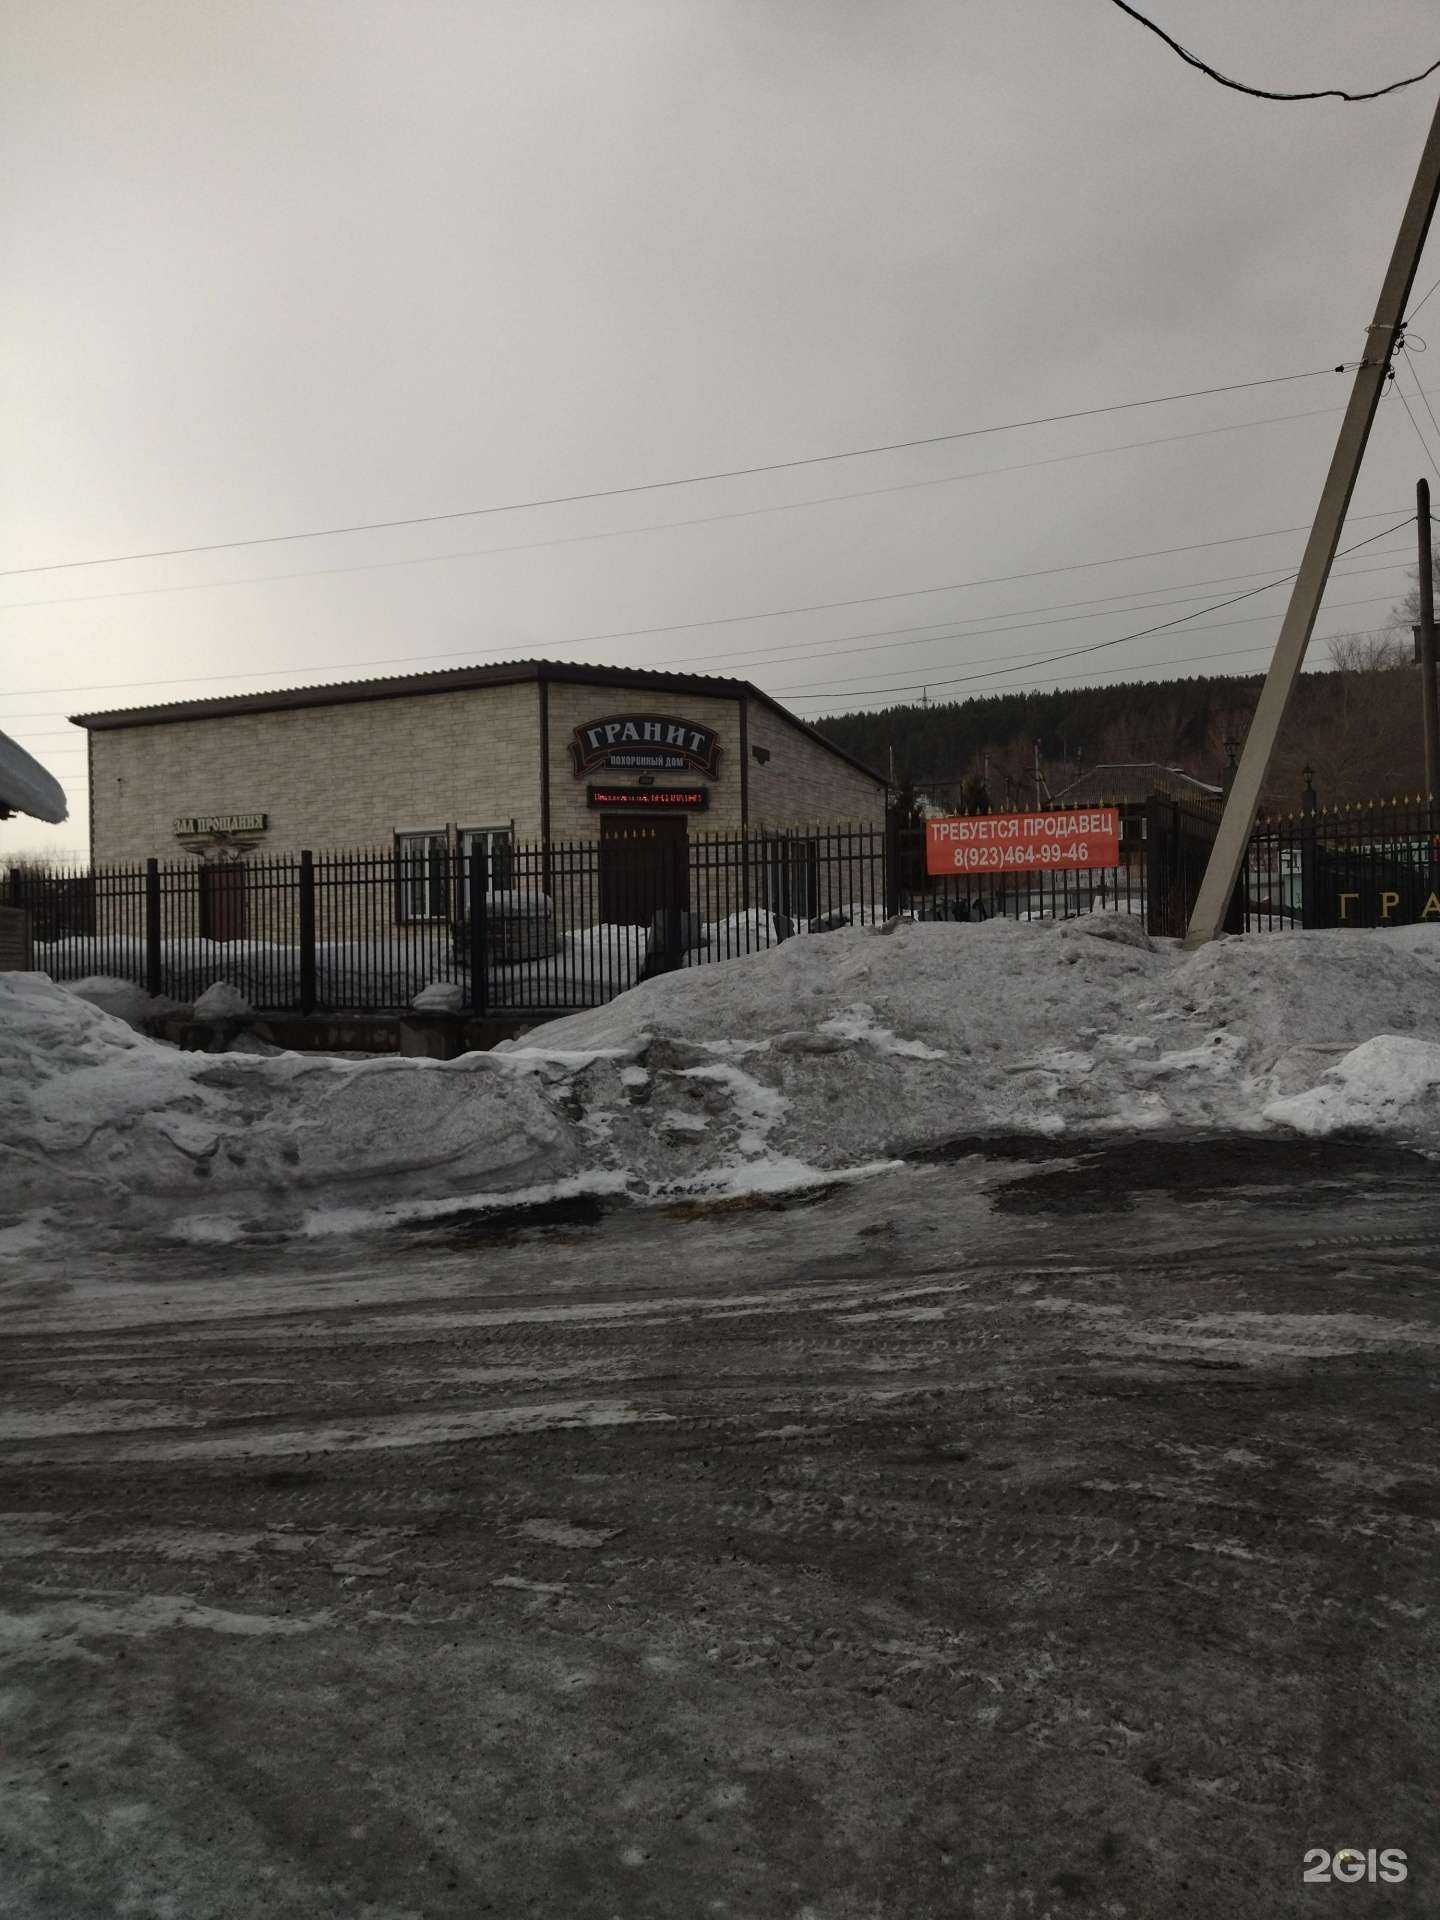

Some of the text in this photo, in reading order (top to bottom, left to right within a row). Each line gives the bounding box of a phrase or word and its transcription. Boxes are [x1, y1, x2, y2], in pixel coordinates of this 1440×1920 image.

[586, 722, 706, 751] ГРАНИТ
[610, 754, 684, 767] ПОХОРОННЫЙ ДОМ
[175, 814, 264, 834] ЗАЛ ПРОЩАНИЯ
[931, 814, 1113, 841] ТРЕБУЕТСЯ ПРОДАВЕЦ
[954, 842, 1089, 869] 8(923)464-99-46
